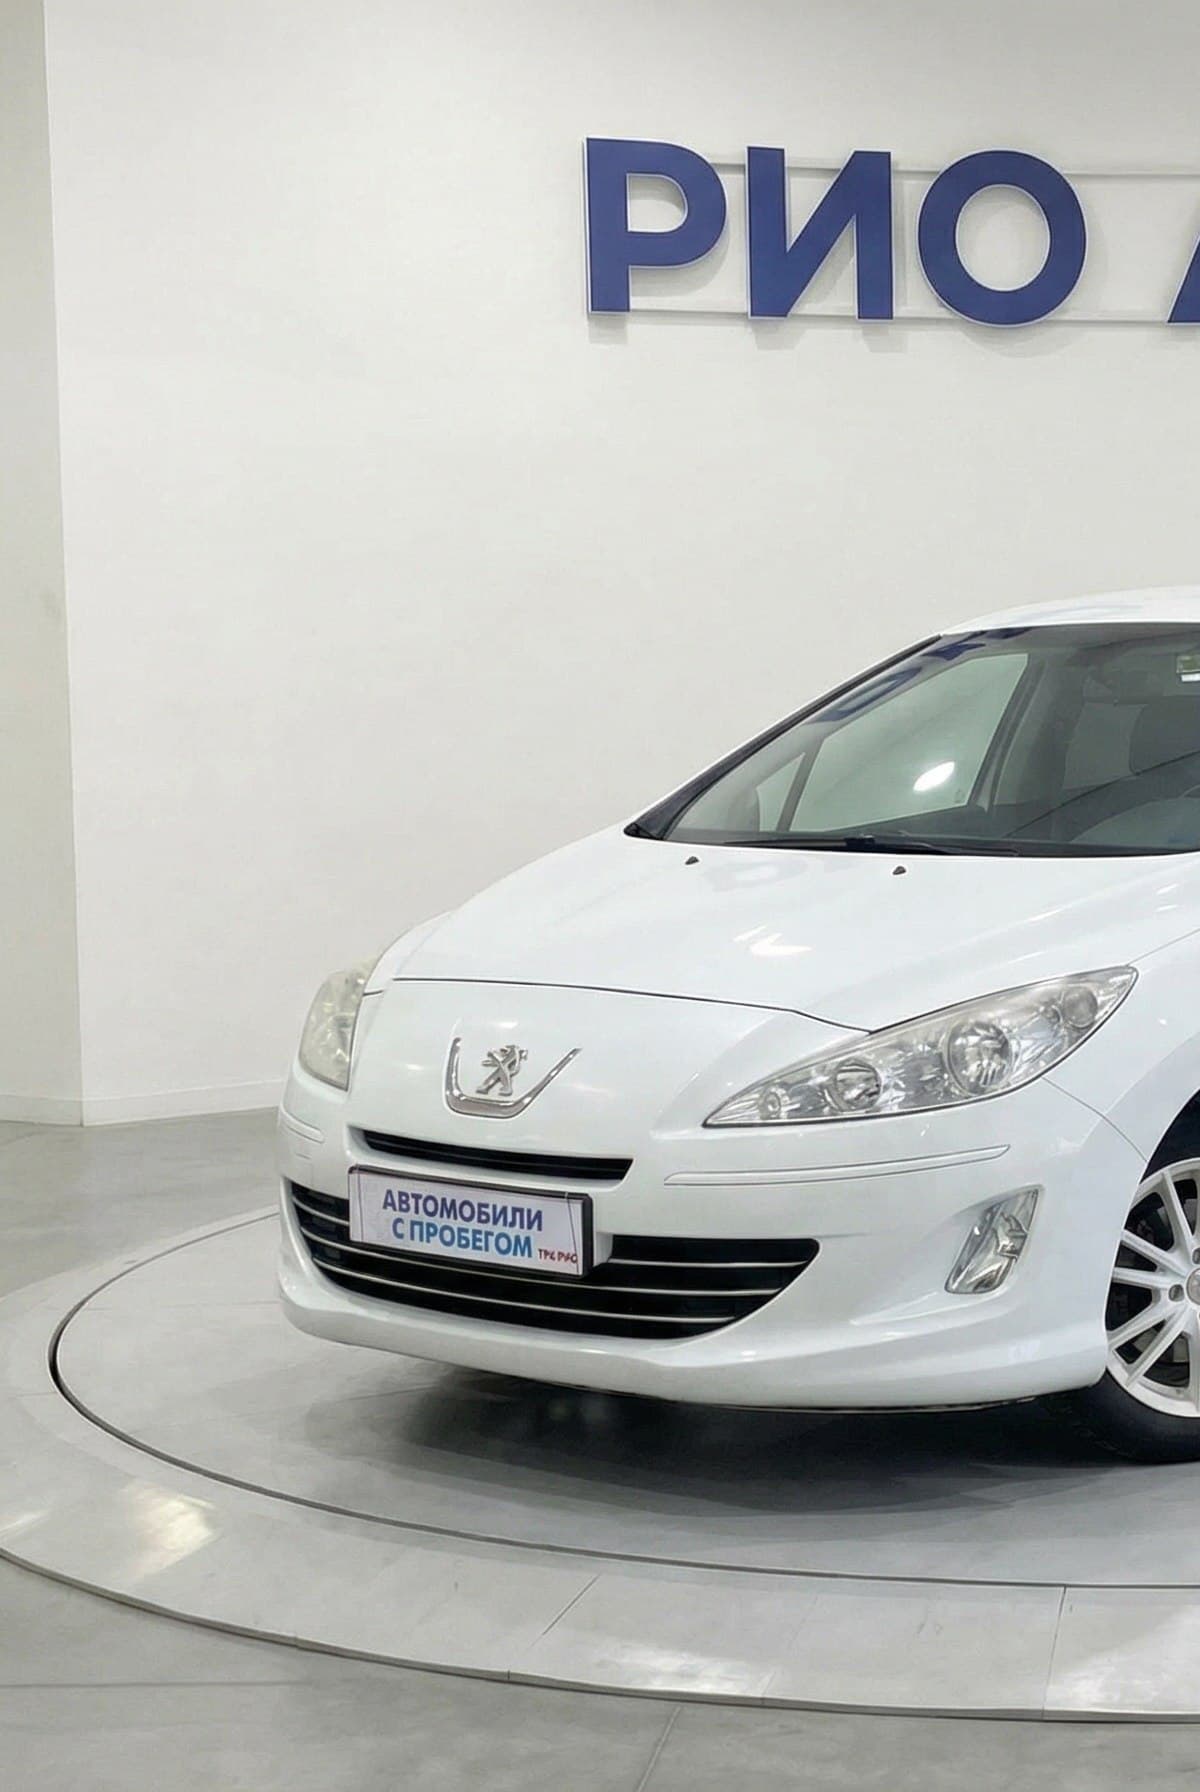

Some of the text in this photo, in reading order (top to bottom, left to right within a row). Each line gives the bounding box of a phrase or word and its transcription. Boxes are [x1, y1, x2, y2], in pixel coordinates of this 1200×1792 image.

[585, 138, 1087, 325] РИО
[382, 1189, 543, 1231] АВТОМОБИЛИ
[392, 1218, 532, 1258] С ПРОБЕГОМ
